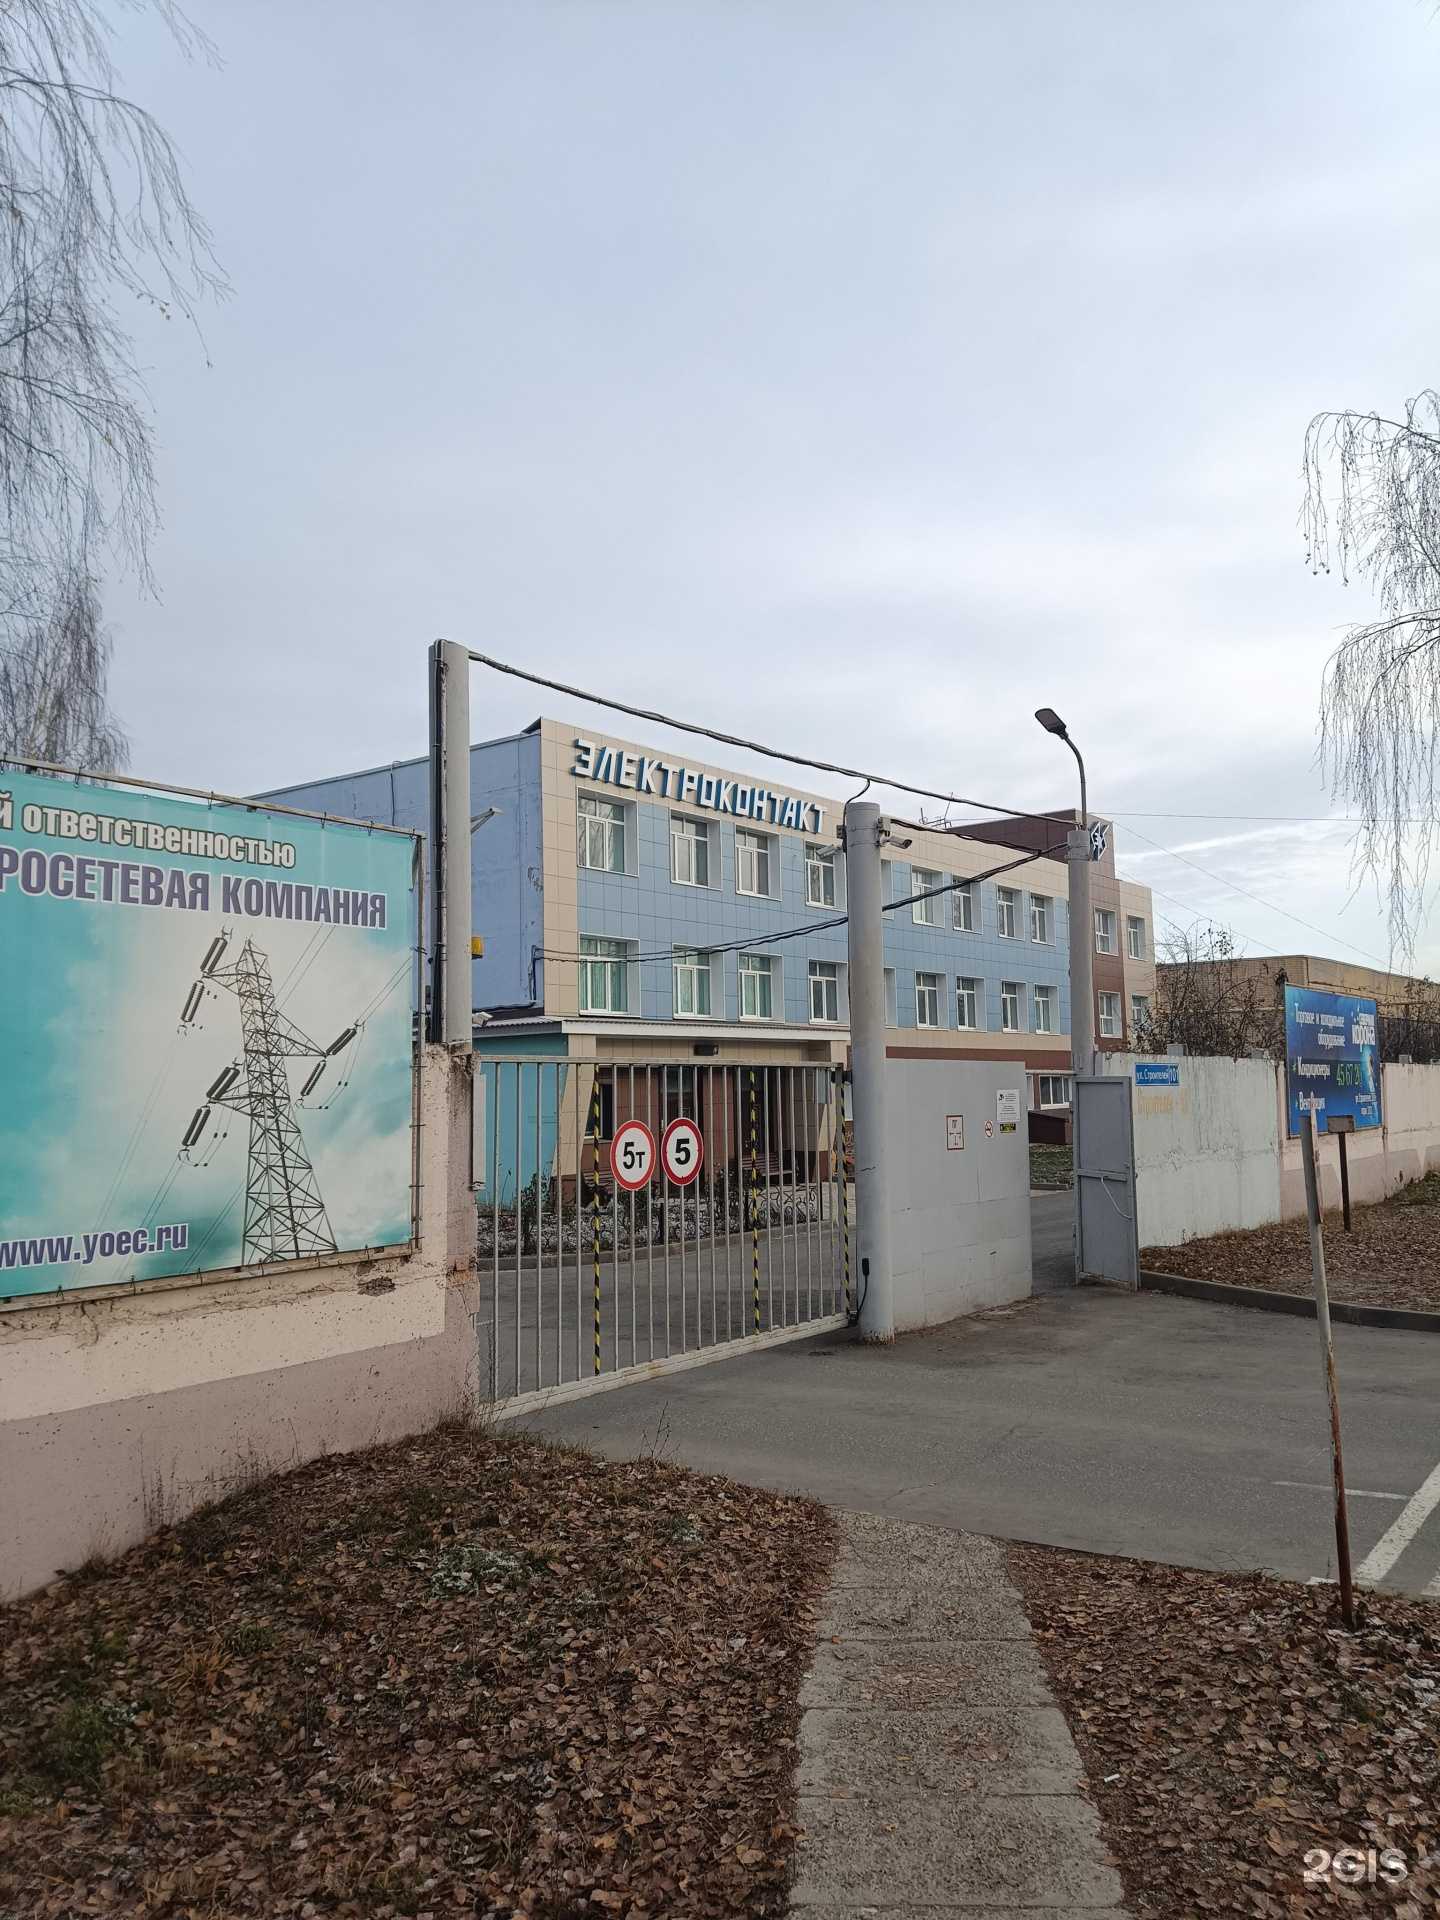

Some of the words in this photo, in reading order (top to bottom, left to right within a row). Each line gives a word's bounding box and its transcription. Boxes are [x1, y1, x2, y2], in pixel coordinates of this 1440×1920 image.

[571, 737, 828, 834] ЭЛЕКТРОКОНТАКТ
[22, 803, 296, 869] ответственностью
[221, 875, 387, 930] КОМПАНИЯ
[674, 1137, 691, 1166] 5
